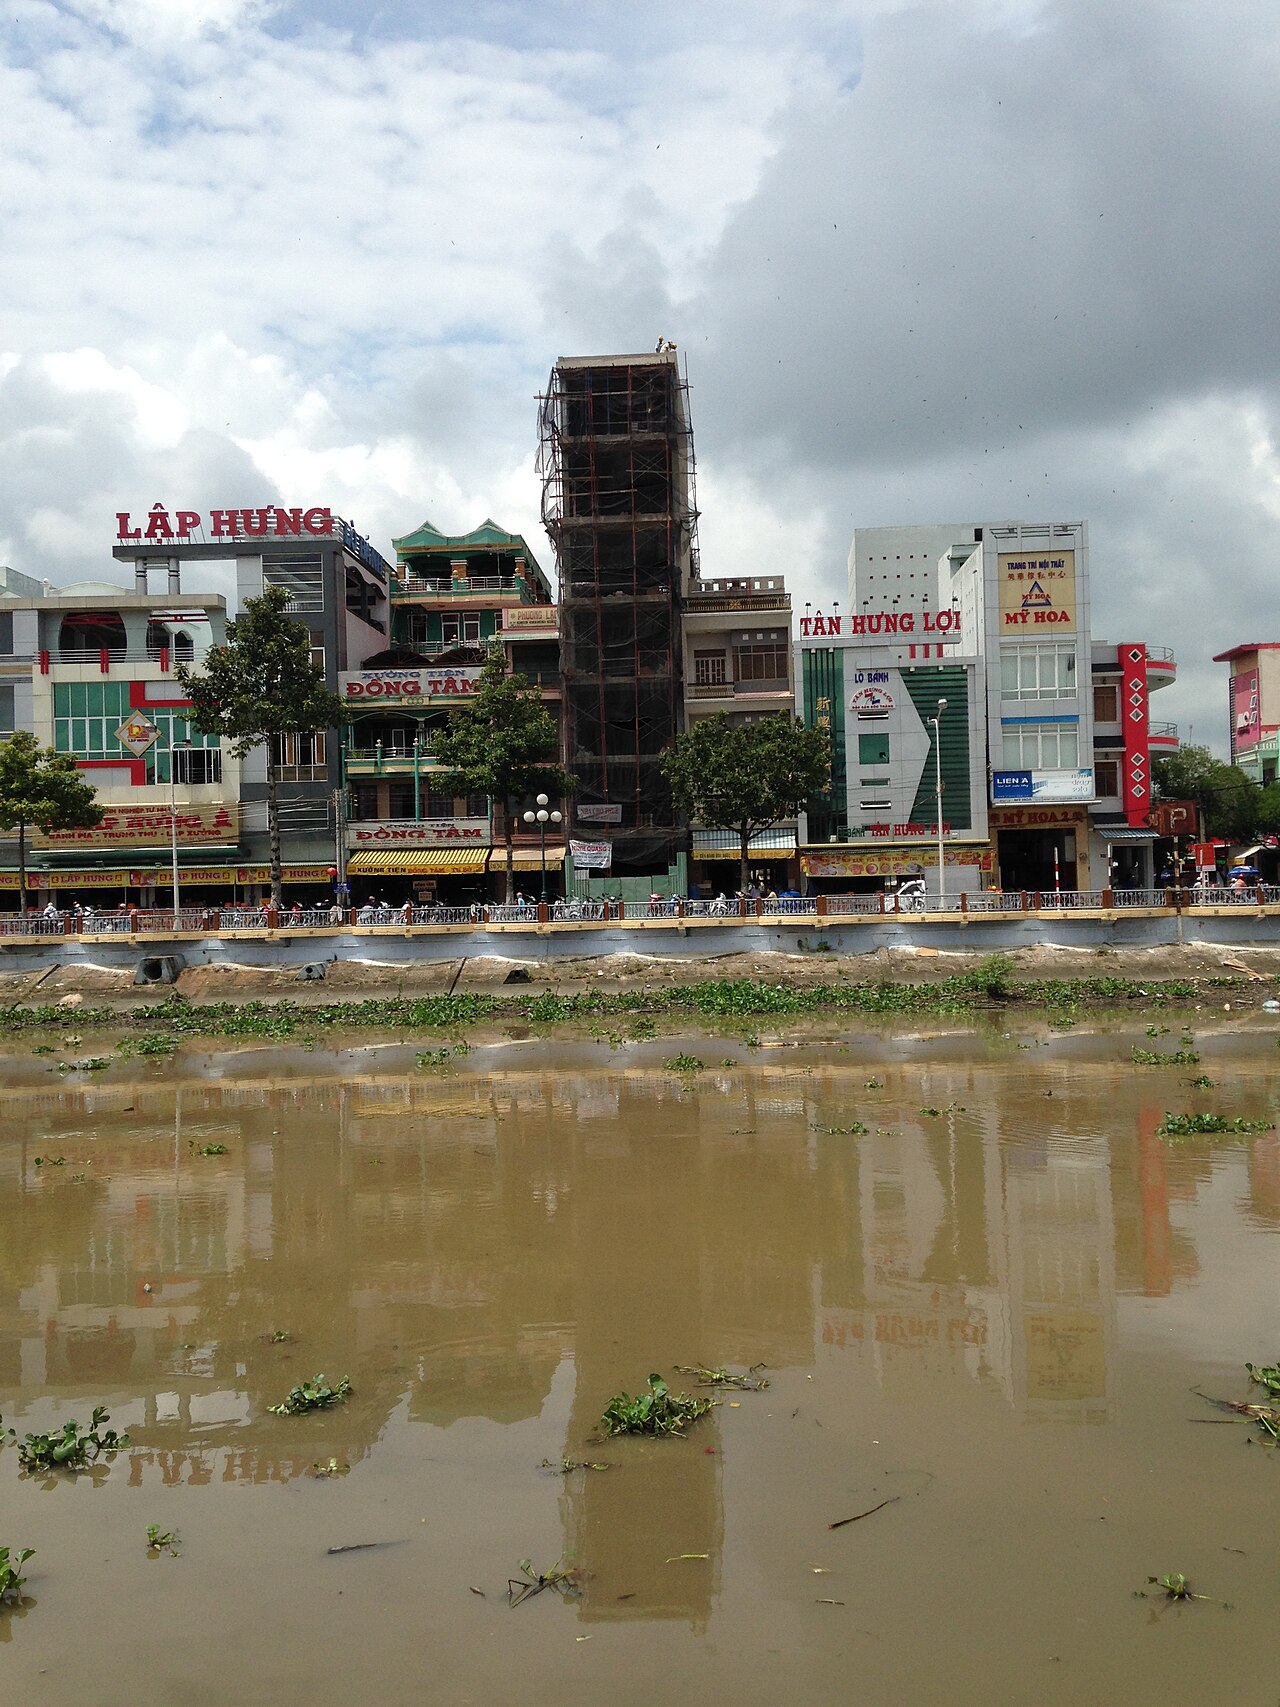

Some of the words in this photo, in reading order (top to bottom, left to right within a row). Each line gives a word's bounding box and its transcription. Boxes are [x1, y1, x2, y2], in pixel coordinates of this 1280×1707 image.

[116, 503, 201, 543] LẬP
[210, 505, 334, 536] HƯNG
[1007, 562, 1026, 570] TRANG
[1028, 560, 1037, 569] TRÍ
[1051, 559, 1065, 568] THẤT
[800, 610, 841, 636] TÂN
[852, 611, 914, 634] HƯNG
[923, 609, 960, 635] LỢI
[1005, 609, 1030, 624] MỸ
[1034, 610, 1070, 623] HOA
[362, 671, 421, 679] XƯỞNG
[855, 671, 864, 683] LÒ
[867, 670, 889, 683] BÁNH
[347, 679, 421, 696] ĐỒNG
[428, 677, 480, 695] TÂM
[1003, 810, 1024, 824] MỸ
[1028, 812, 1058, 823] HOA
[1062, 811, 1069, 822] 2
[1170, 808, 1187, 828] P
[356, 826, 426, 840] ĐỒNG
[433, 825, 482, 838] TÂM
[869, 821, 890, 837] TÂN
[894, 822, 925, 836] HƯNG
[267, 871, 287, 879] LP
